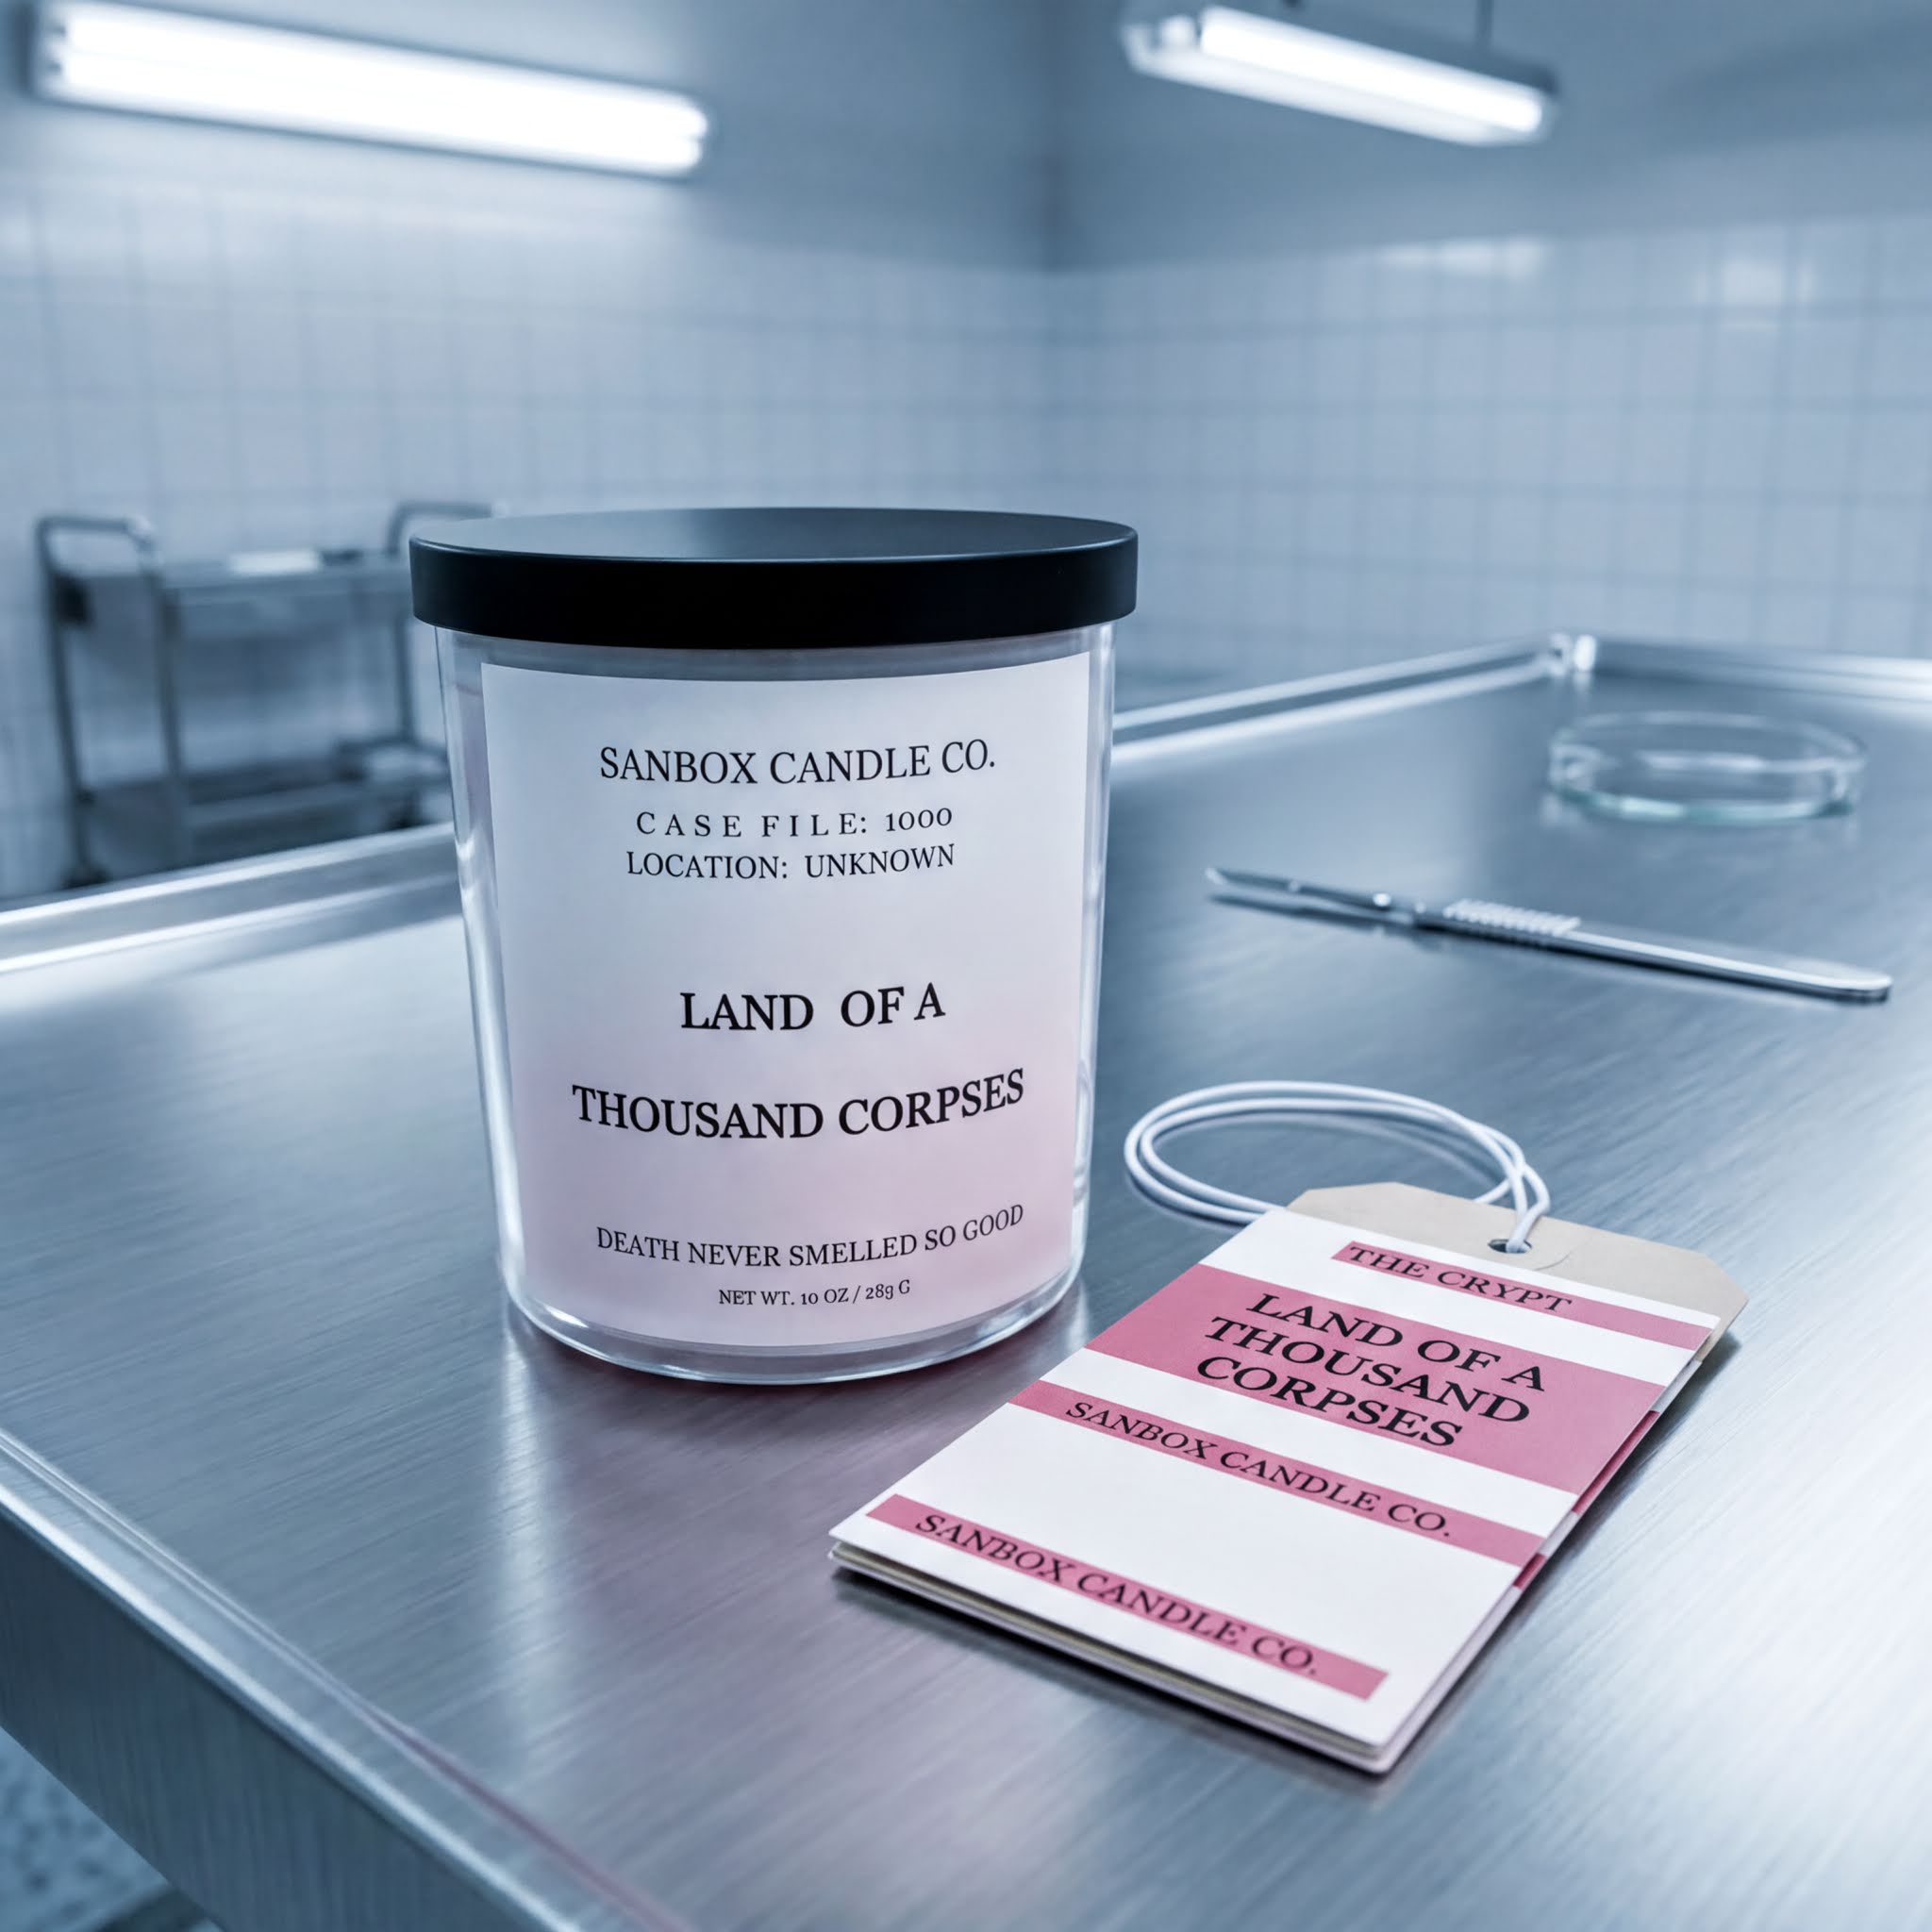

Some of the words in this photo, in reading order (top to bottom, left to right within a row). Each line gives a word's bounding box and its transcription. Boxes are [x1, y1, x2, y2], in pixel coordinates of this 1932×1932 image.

[601, 747, 758, 785] SANBOX
[771, 745, 931, 785] CANDLE
[942, 739, 995, 774] CO.
[637, 811, 742, 838] CASE
[761, 813, 867, 838] FILE:
[886, 808, 953, 832] 1000
[626, 851, 788, 879] LOCATION:
[805, 843, 955, 878] UNKNOWN
[680, 992, 814, 1031] LAND
[841, 986, 905, 1027] OF
[914, 982, 946, 1021] A
[572, 1085, 824, 1139] THOUSAND
[839, 1068, 1024, 1136] CORPSES
[597, 1227, 679, 1262] DEATH
[688, 1242, 781, 1267] NEVER
[790, 1234, 917, 1266] SMELLED
[924, 1225, 957, 1251] SO
[963, 1204, 1024, 1241] GOOD
[719, 1290, 757, 1305] NET
[760, 1291, 795, 1306] WT.
[801, 1292, 819, 1305] 10
[824, 1288, 849, 1304] OZ
[898, 1279, 910, 1295] G
[1347, 1245, 1429, 1279] THE
[1437, 1270, 1573, 1312] CRYPT
[1205, 1317, 1530, 1423] THOUSAND
[1246, 1293, 1404, 1347] LAND
[1418, 1340, 1502, 1373] OF
[1502, 1365, 1546, 1392] A
[1197, 1356, 1463, 1447] CORPSES
[1065, 1401, 1219, 1460] SANBOX
[1220, 1450, 1382, 1512] CANDLE
[1388, 1503, 1451, 1538] CO.
[915, 1514, 1076, 1583] SANBOX
[1076, 1571, 1241, 1645] CANDLE
[1251, 1635, 1318, 1675] CO.
